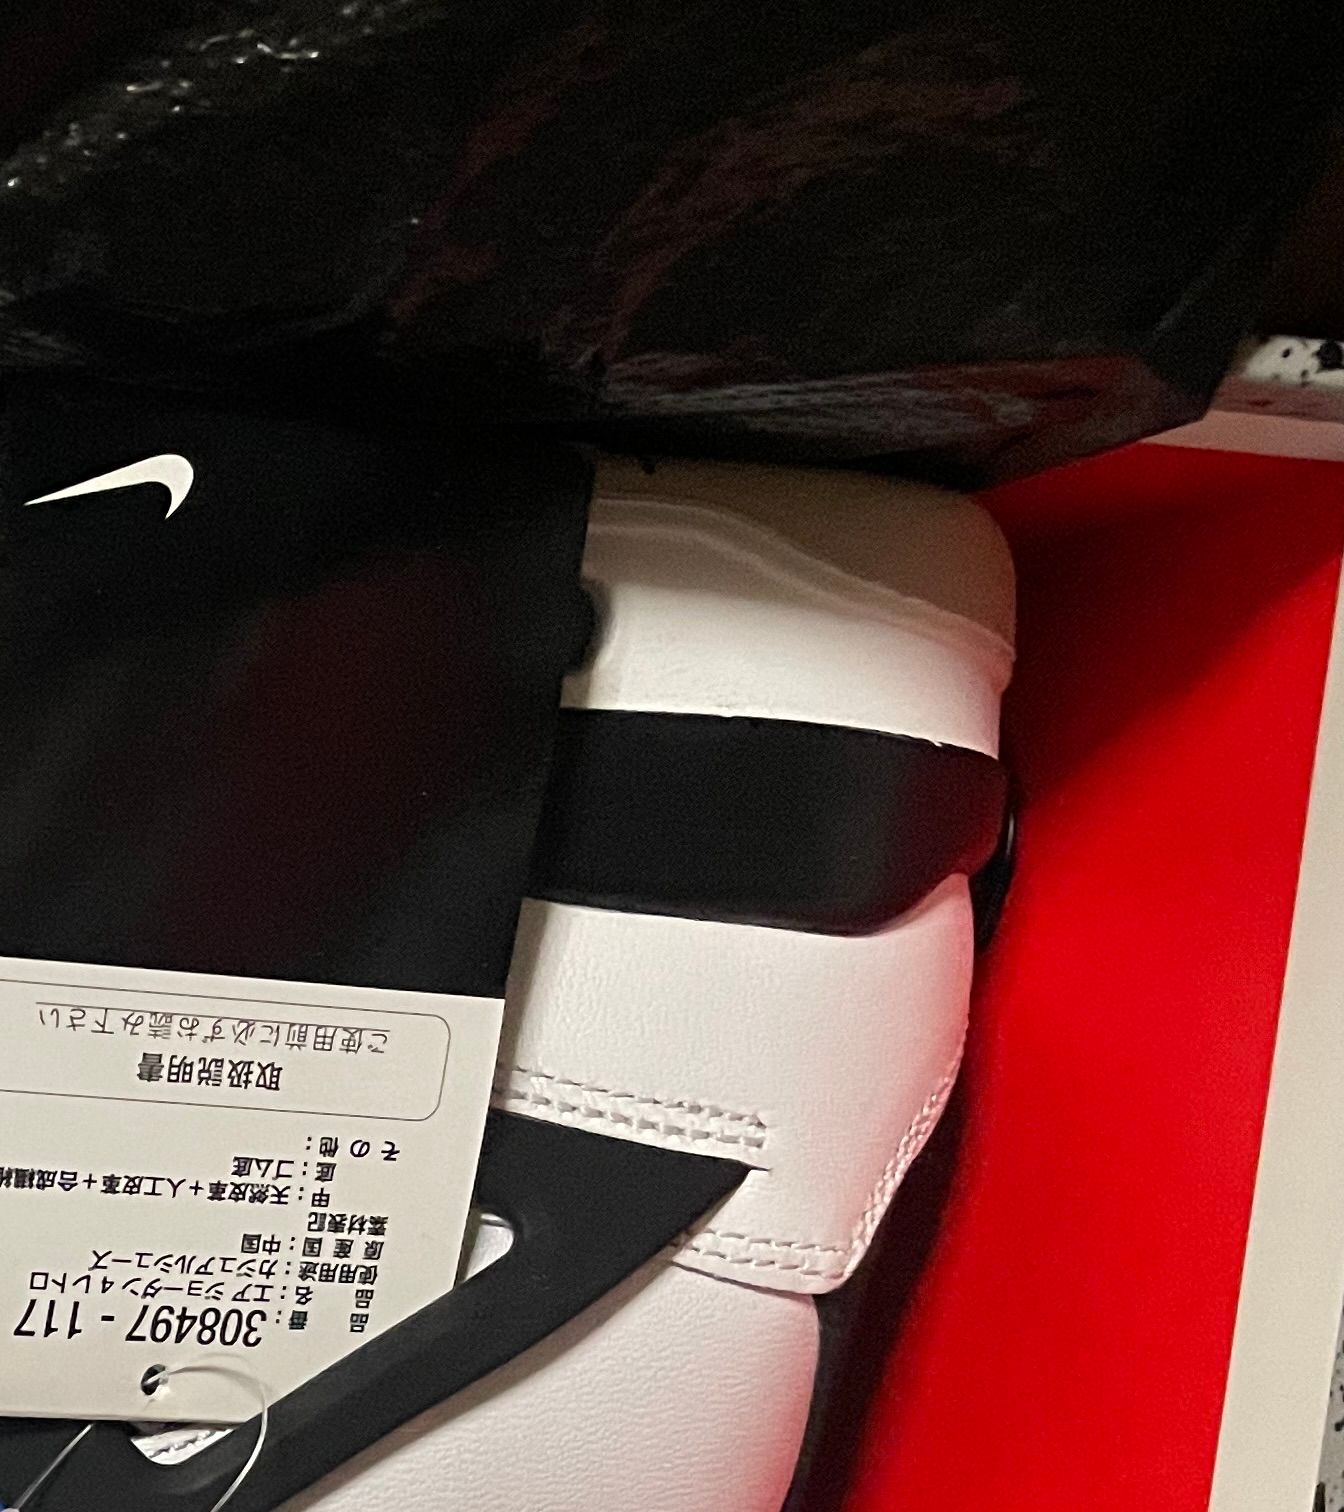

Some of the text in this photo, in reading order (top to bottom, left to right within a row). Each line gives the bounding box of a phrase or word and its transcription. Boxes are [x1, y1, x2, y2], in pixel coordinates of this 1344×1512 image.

[39, 1007, 388, 1055] ご使用前に必ずお読み下さい
[136, 1052, 283, 1092] 取扱説明書
[241, 1233, 281, 1254] 中国
[307, 1212, 388, 1236] 素材表記
[14, 1299, 82, 1339] 117
[125, 1305, 267, 1347] 308497
